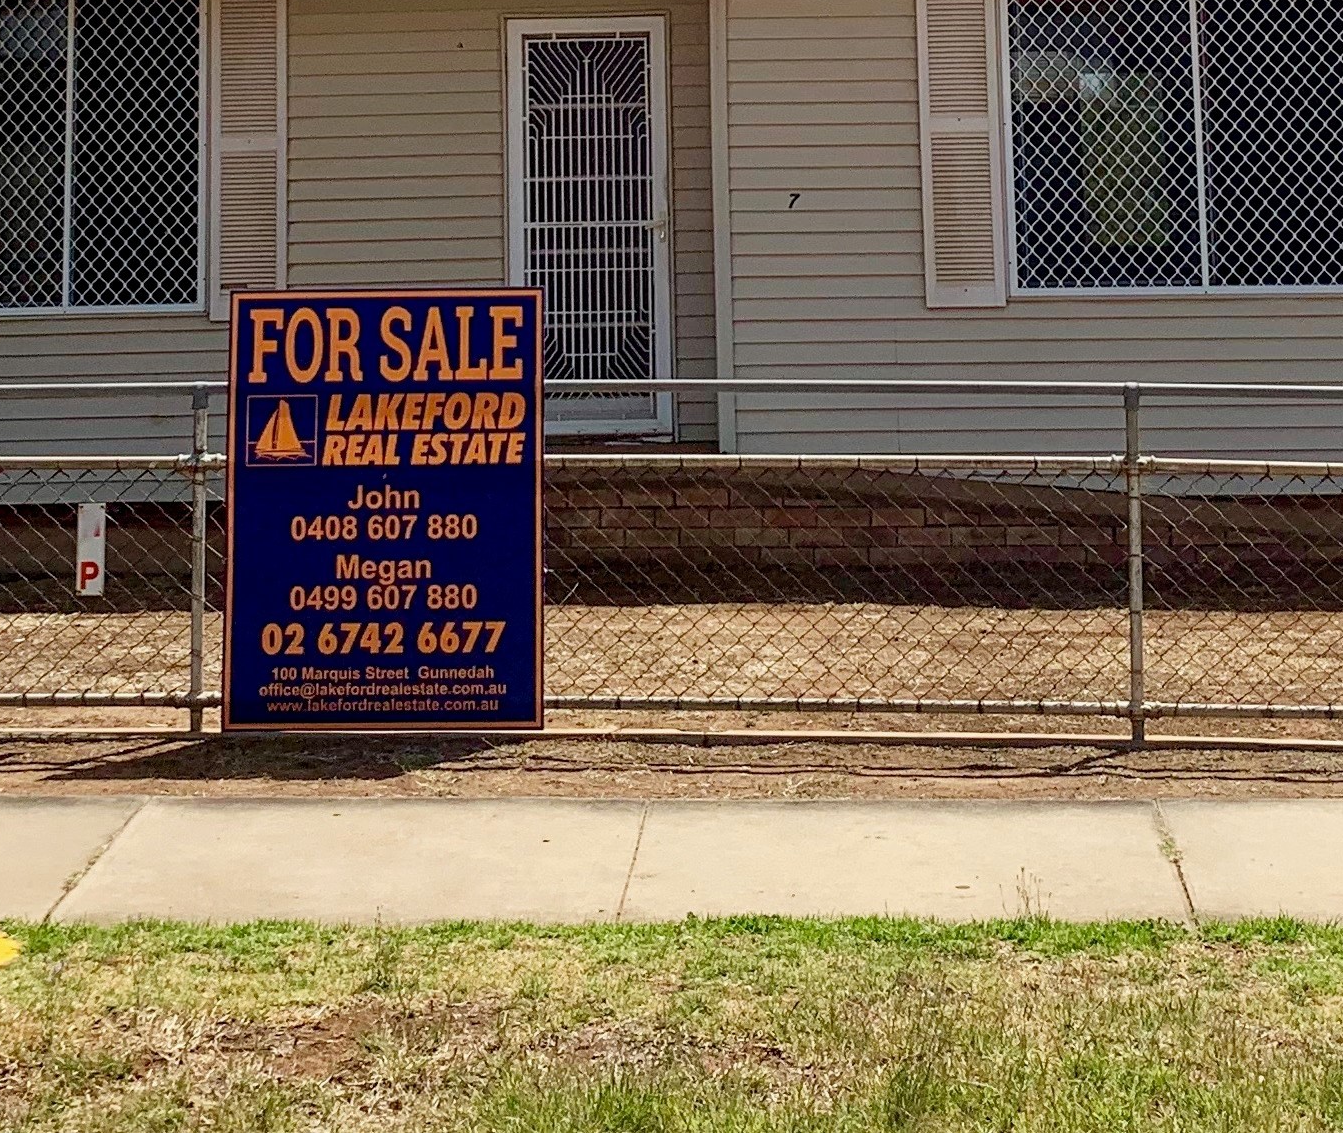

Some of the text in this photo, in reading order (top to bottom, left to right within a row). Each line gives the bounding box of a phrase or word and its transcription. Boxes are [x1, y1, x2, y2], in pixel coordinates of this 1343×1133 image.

[788, 193, 801, 208] 7
[248, 306, 523, 383] FOR SALE
[325, 392, 526, 431] LAKEFORD
[322, 432, 526, 466] REAL ESTATE
[347, 485, 420, 509] John
[290, 514, 478, 540] 0408 607 880
[80, 561, 99, 590] P
[335, 554, 432, 585] Megan
[289, 584, 478, 610] 0499 607 880
[261, 621, 507, 655] 02 6742 6677
[271, 665, 495, 683] 100 Marquis Street Gunnedah
[258, 681, 507, 700] office@lakefordrealestate.com.au
[266, 698, 499, 713] www.lakefordrealestate.com.au
